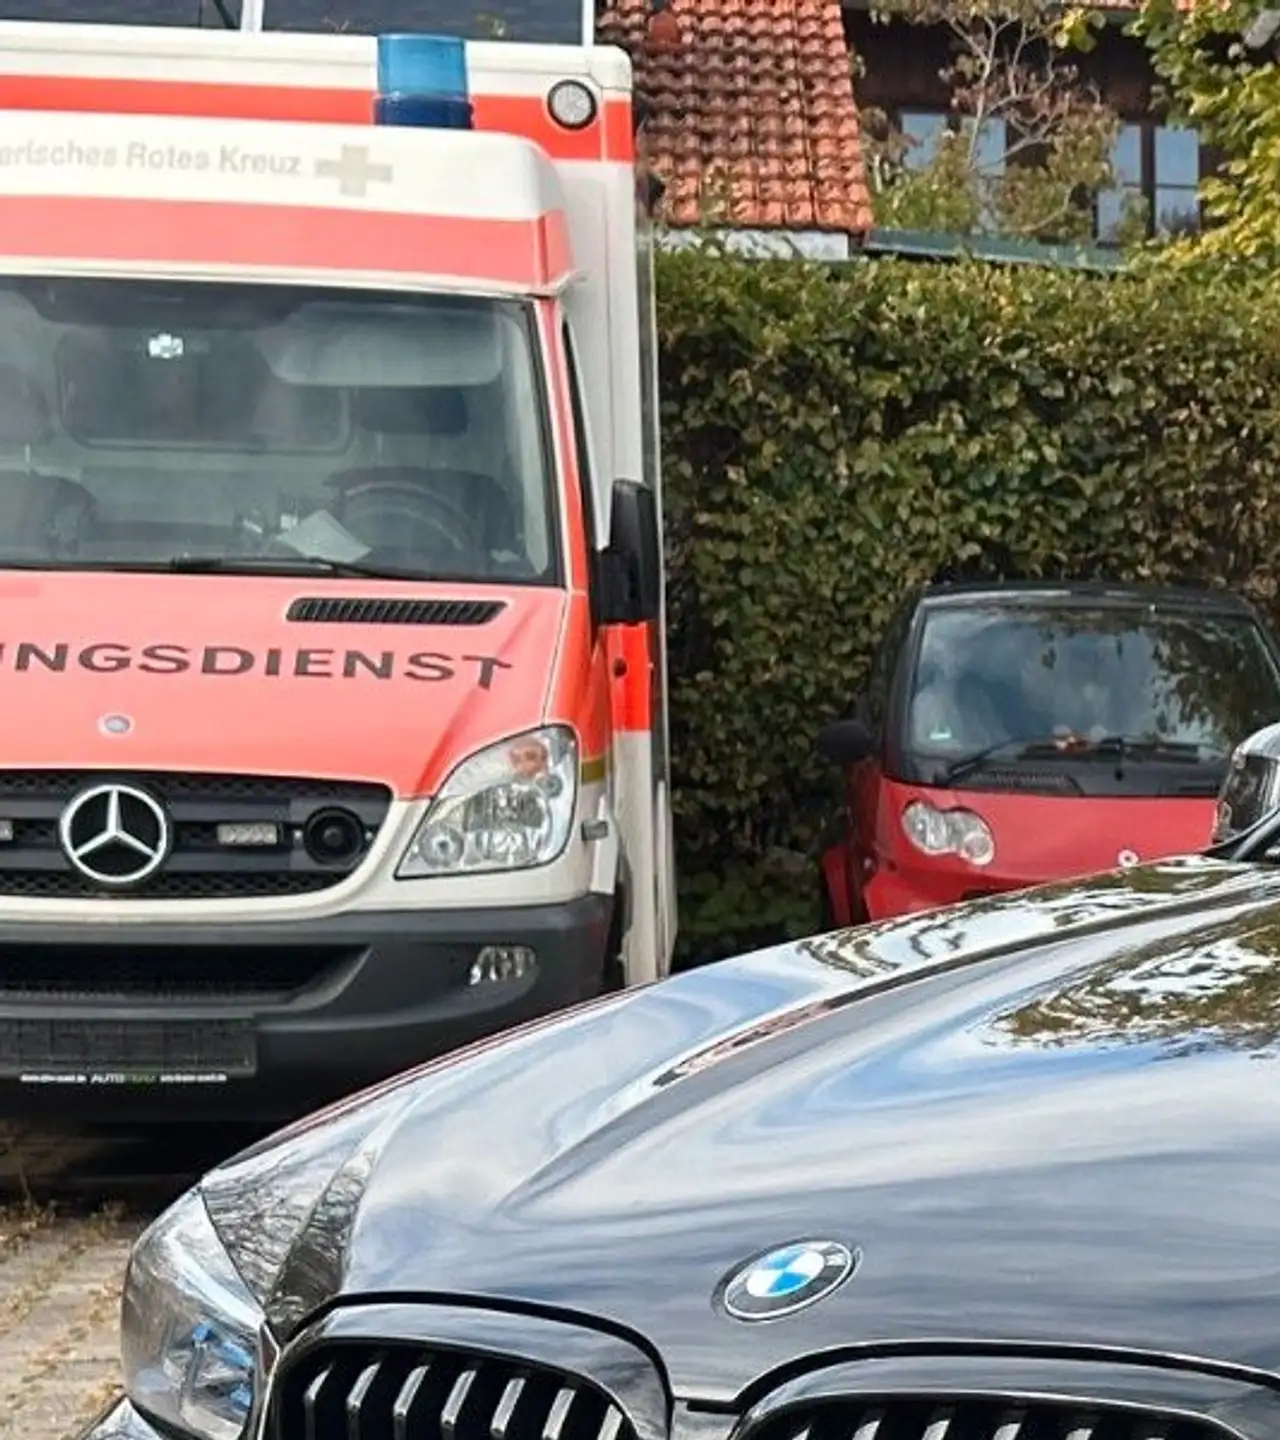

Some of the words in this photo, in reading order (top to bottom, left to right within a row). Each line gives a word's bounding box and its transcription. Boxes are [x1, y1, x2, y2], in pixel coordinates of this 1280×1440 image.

[126, 140, 210, 172] Rotes
[218, 144, 302, 176] Kreuz
[0, 641, 513, 690] NGSDIENST
